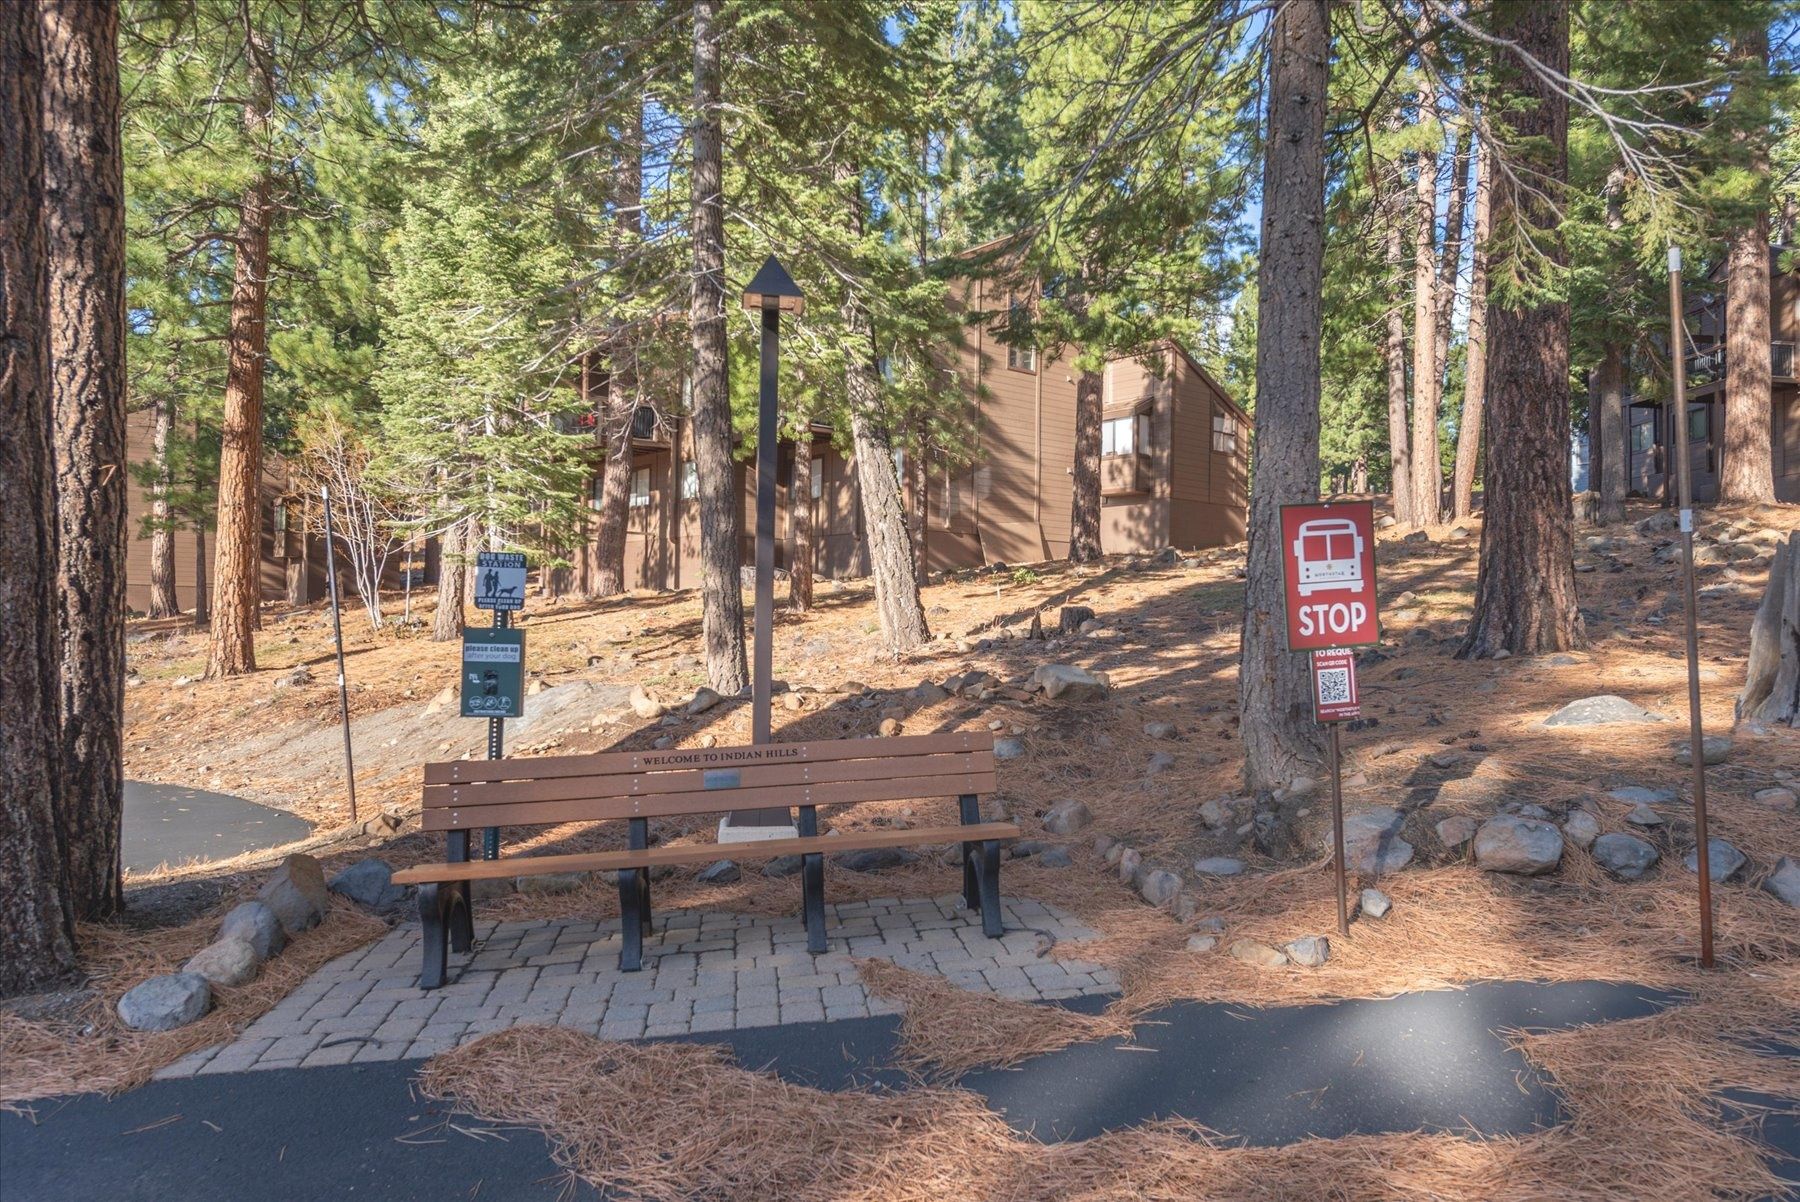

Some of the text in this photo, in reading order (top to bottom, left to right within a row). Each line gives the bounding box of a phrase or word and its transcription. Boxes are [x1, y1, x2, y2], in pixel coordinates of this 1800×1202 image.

[497, 553, 524, 561] WASTE
[482, 560, 521, 568] STATION
[1298, 601, 1367, 636] STOP
[490, 645, 509, 653] clean
[1315, 649, 1326, 657] TO
[467, 651, 484, 659] after
[643, 748, 798, 766] WELCOME TO INDIAN HILLS
